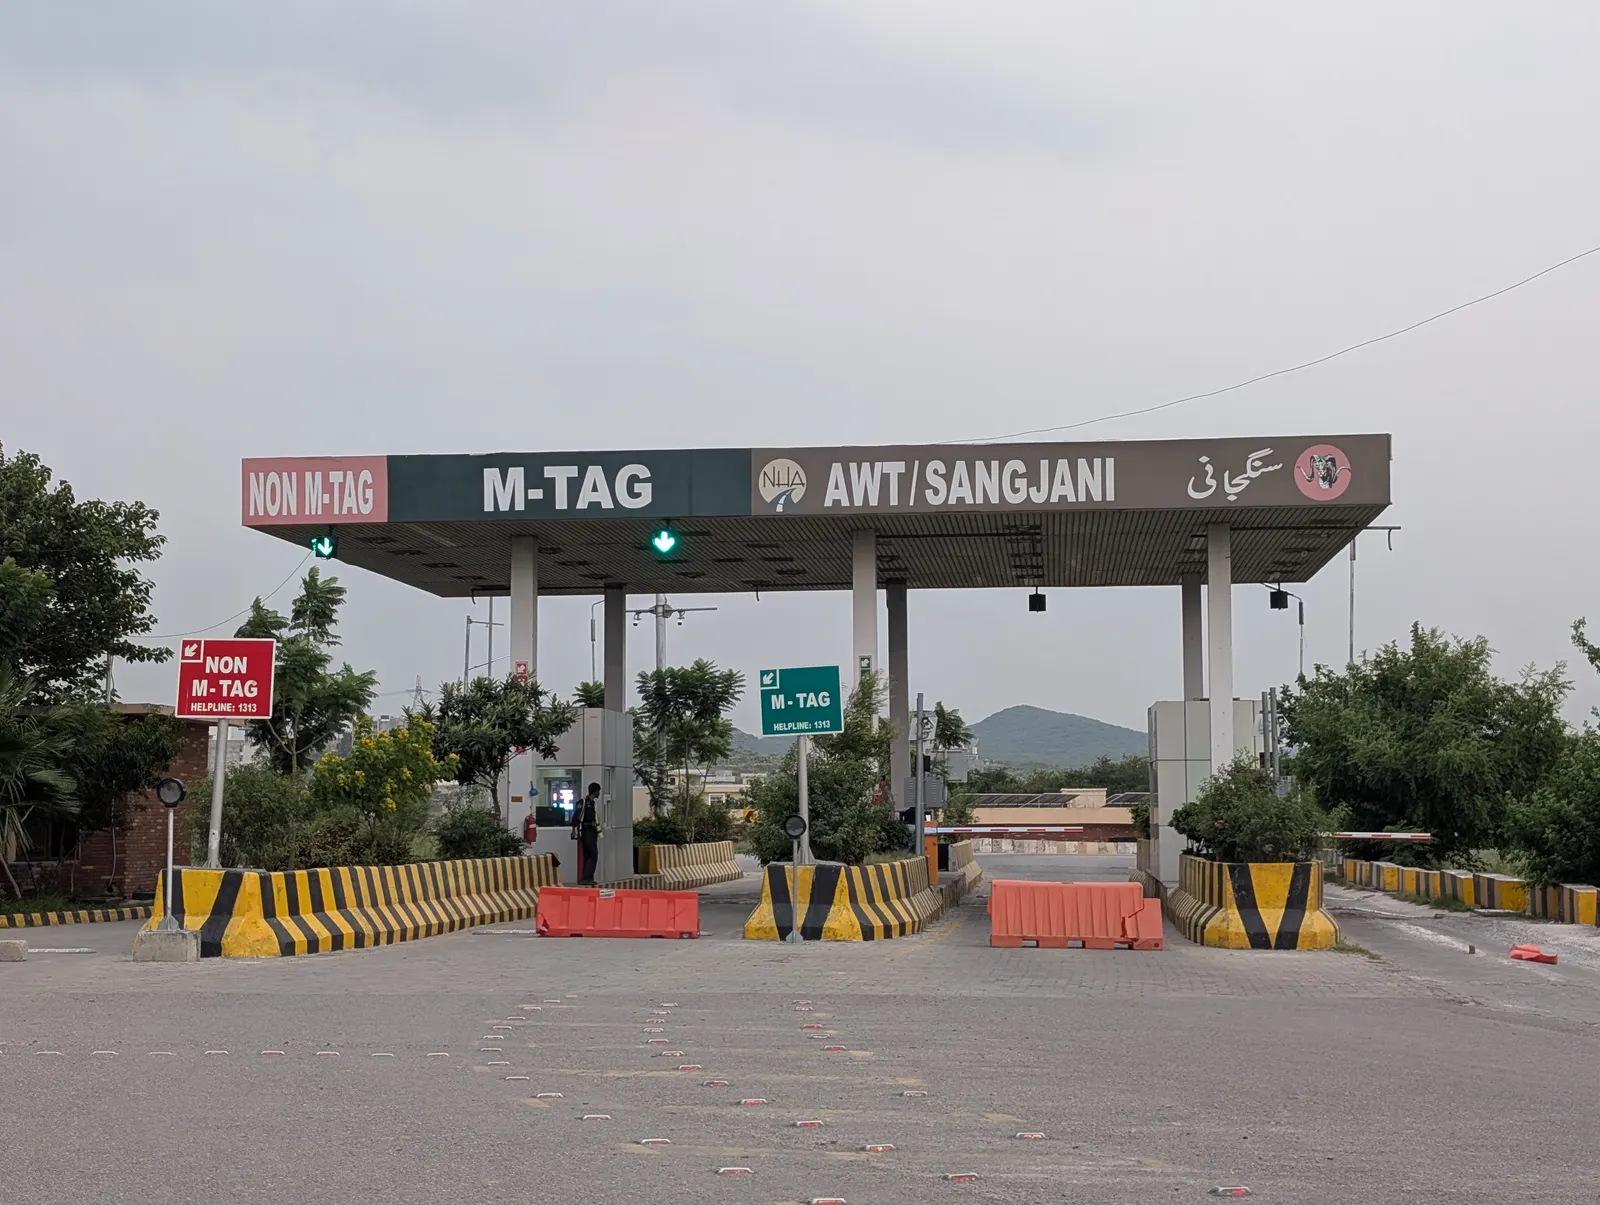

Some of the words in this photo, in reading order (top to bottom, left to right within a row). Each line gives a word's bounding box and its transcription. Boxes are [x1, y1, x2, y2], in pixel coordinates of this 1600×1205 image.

[483, 463, 653, 512] M-TAG
[762, 466, 806, 489] NHA
[249, 471, 297, 516] NON
[304, 469, 374, 516] M-TAG
[205, 656, 248, 674] NON
[190, 702, 236, 712] HELPLINE:
[238, 703, 257, 713] 1313
[773, 722, 812, 731] HELPLINE:
[813, 720, 831, 729] 1313
